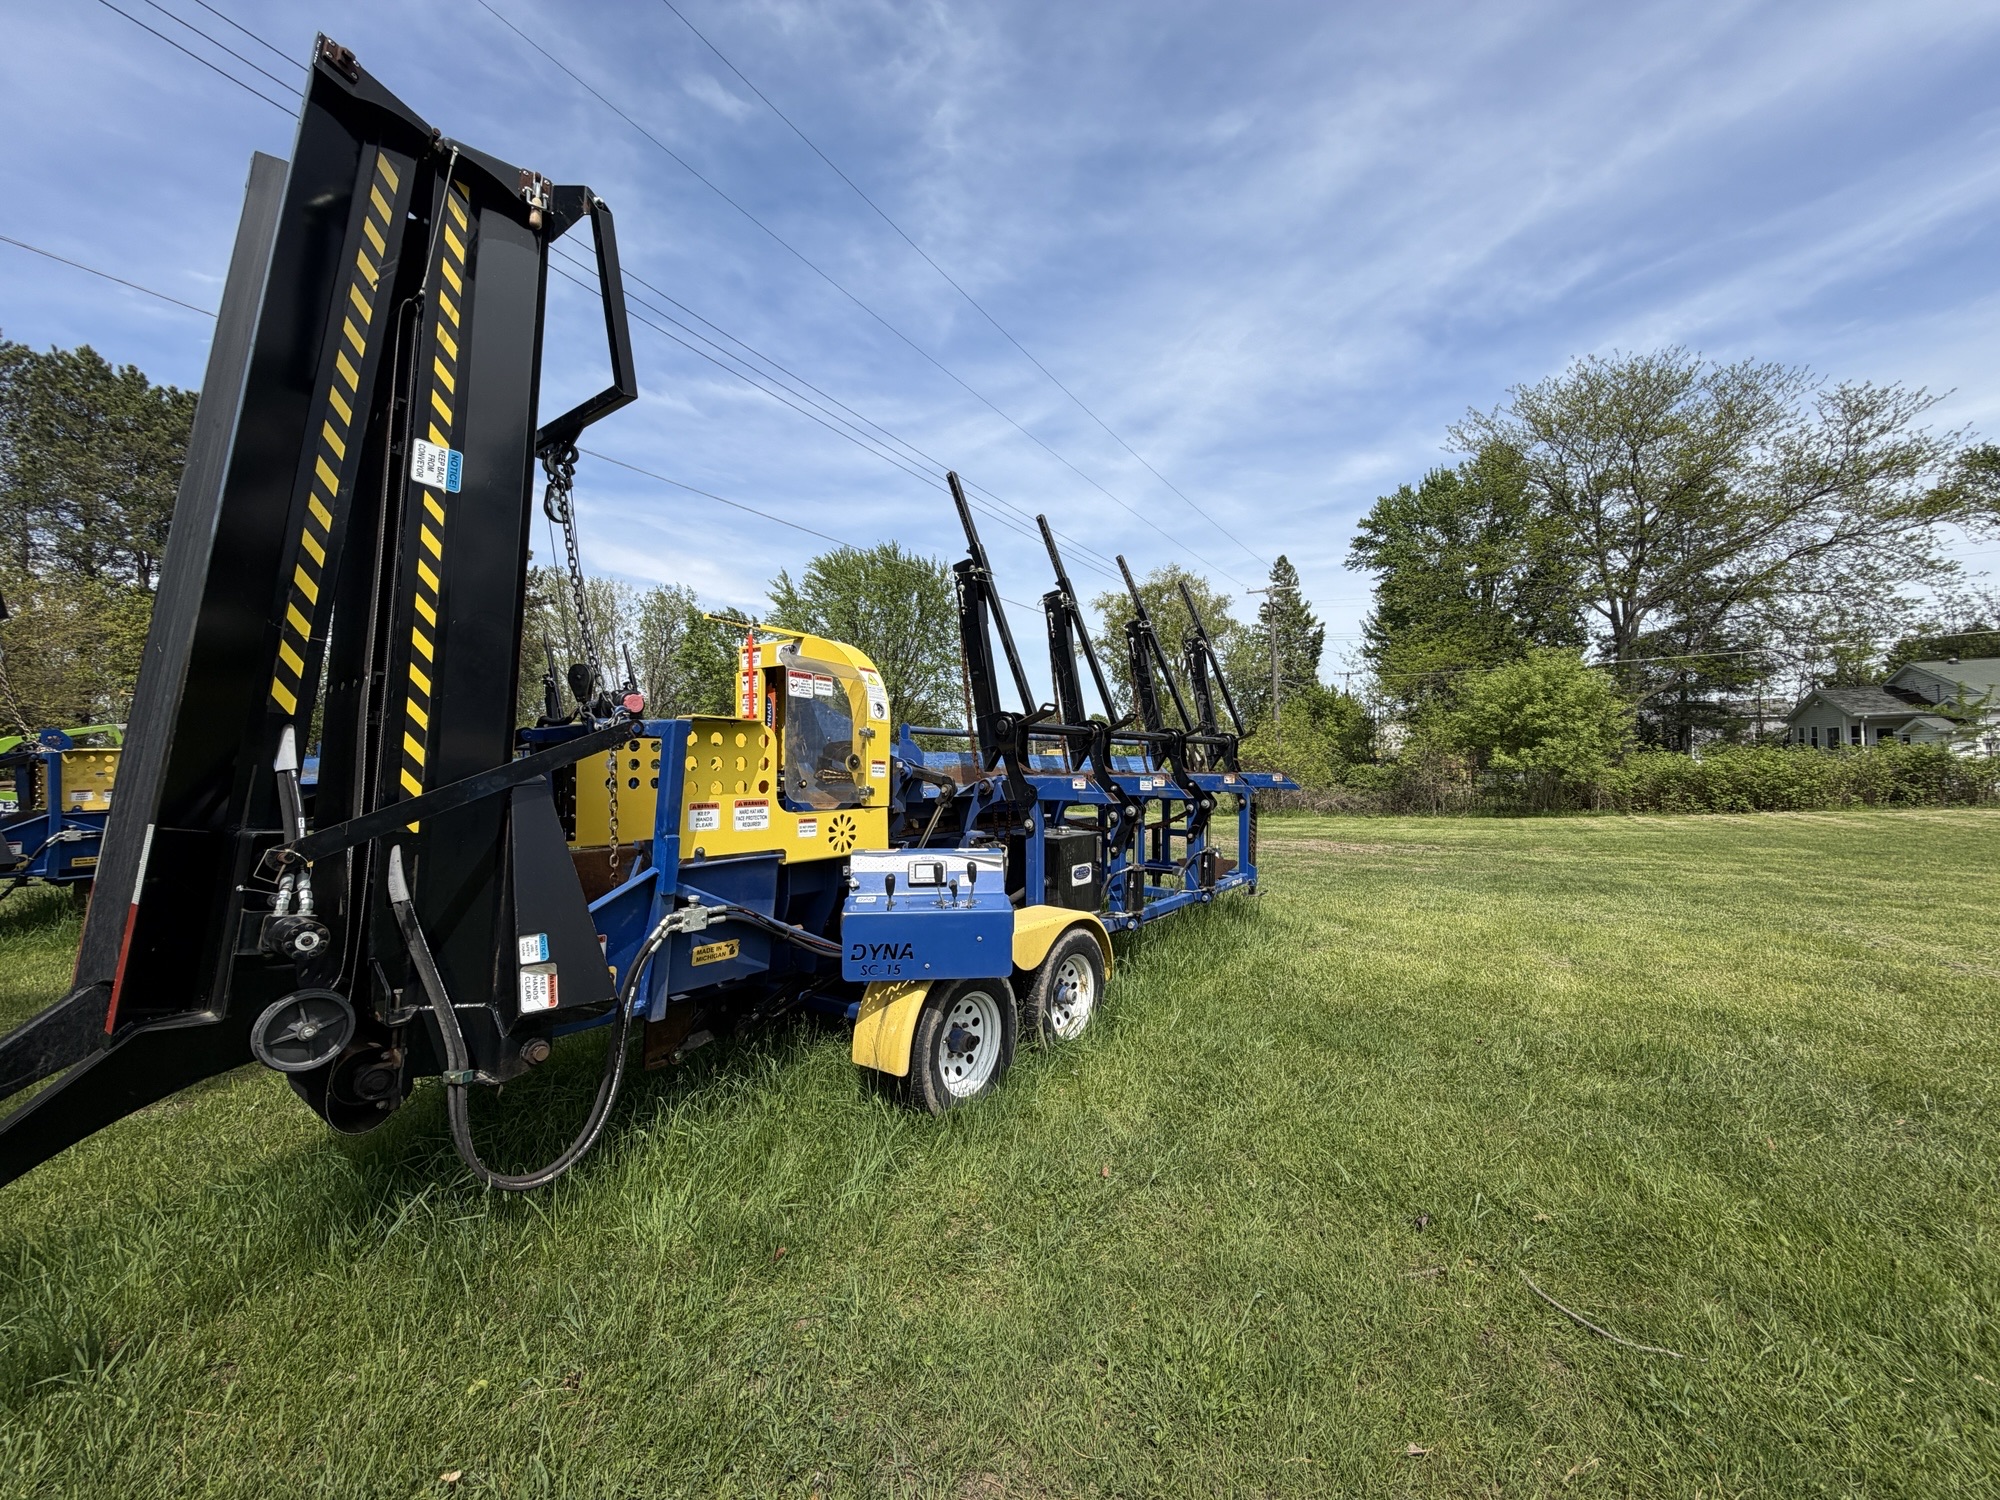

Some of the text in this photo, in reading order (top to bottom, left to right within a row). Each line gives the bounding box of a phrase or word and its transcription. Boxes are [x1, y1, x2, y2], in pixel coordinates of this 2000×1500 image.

[416, 444, 426, 478] CONVEYOR
[427, 454, 436, 472] FROM
[436, 450, 446, 484] KEEP BACK
[448, 454, 459, 488] NOTICE!
[0, 802, 21, 810] EX
[696, 952, 726, 962] MICHIGAN
[697, 947, 714, 955] MADE
[850, 943, 914, 961] DYNA
[860, 964, 901, 976] SC-15
